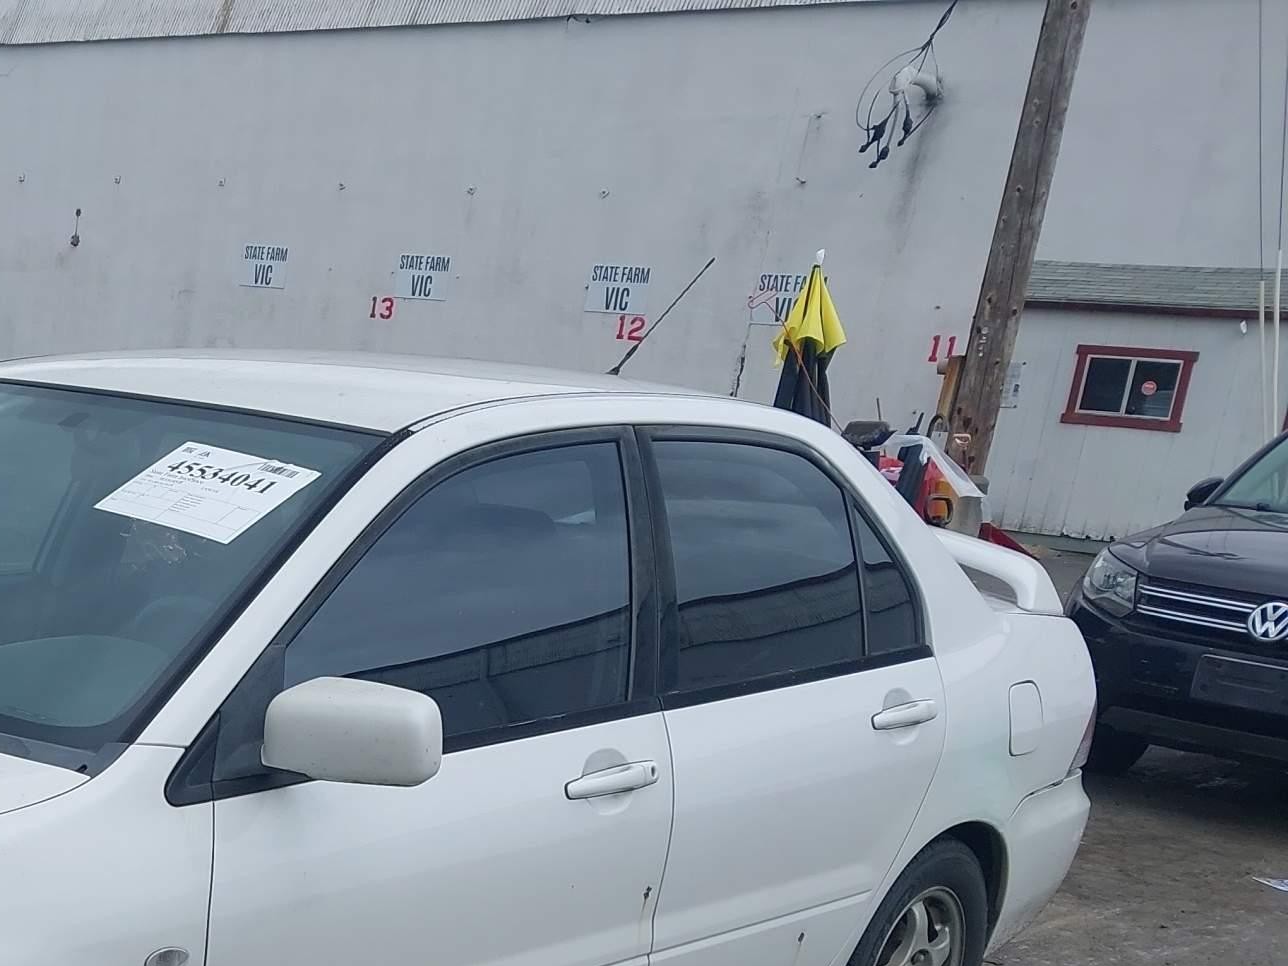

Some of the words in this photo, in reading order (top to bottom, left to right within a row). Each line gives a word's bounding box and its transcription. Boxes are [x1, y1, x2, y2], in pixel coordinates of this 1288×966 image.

[244, 245, 265, 261] STATE
[266, 247, 288, 263] FARM
[399, 254, 424, 271] STATE
[425, 256, 450, 272] FARM
[254, 264, 273, 286] VIC
[411, 275, 433, 297] VIC
[592, 265, 620, 283] STATE
[621, 267, 650, 284] FARM
[759, 274, 792, 292] STATE
[369, 296, 394, 320] 13
[604, 287, 630, 312] VIC
[775, 297, 799, 322] VI
[615, 315, 646, 342] 12
[928, 335, 956, 362] 11
[168, 461, 278, 494] 45534041
